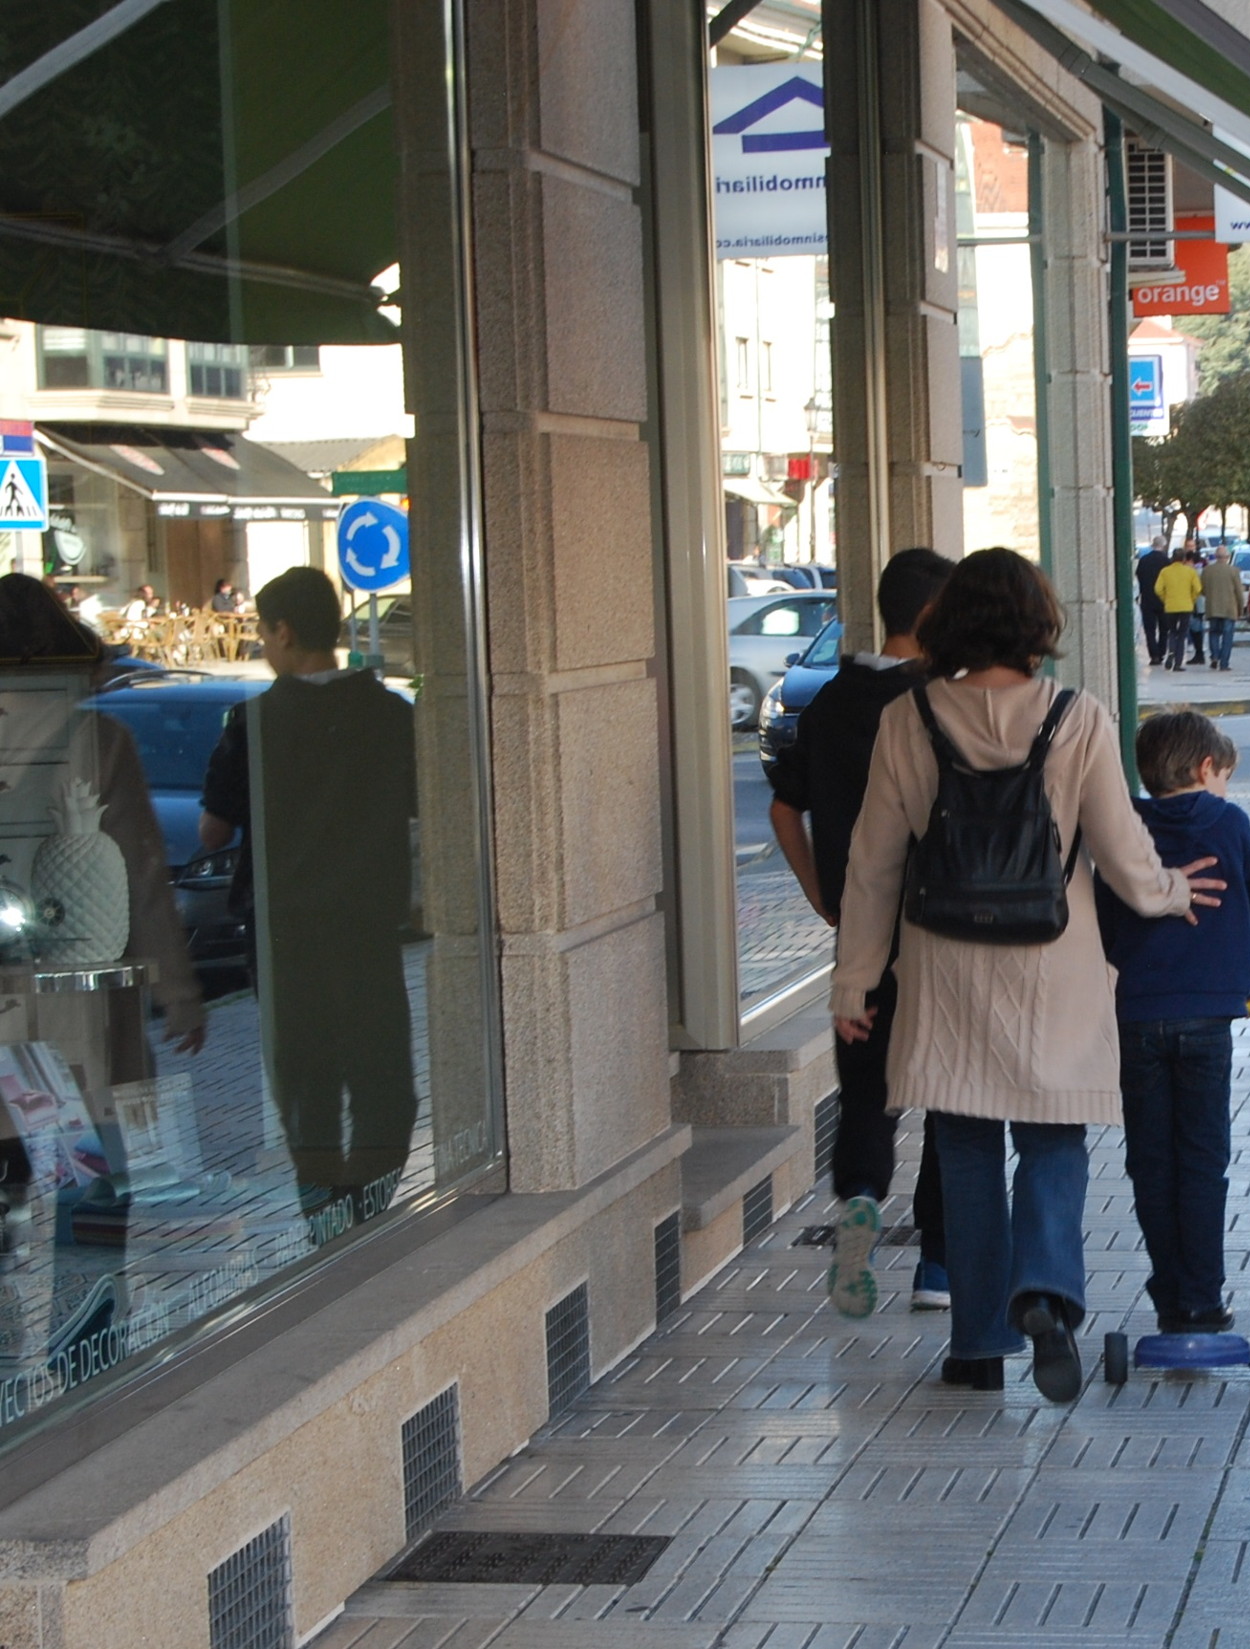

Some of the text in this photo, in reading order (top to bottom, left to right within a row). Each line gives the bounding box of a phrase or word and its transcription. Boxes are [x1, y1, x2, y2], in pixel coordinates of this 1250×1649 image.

[1137, 283, 1220, 307] orange
[56, 1345, 80, 1396] DE
[308, 1193, 353, 1249] PINTADO
